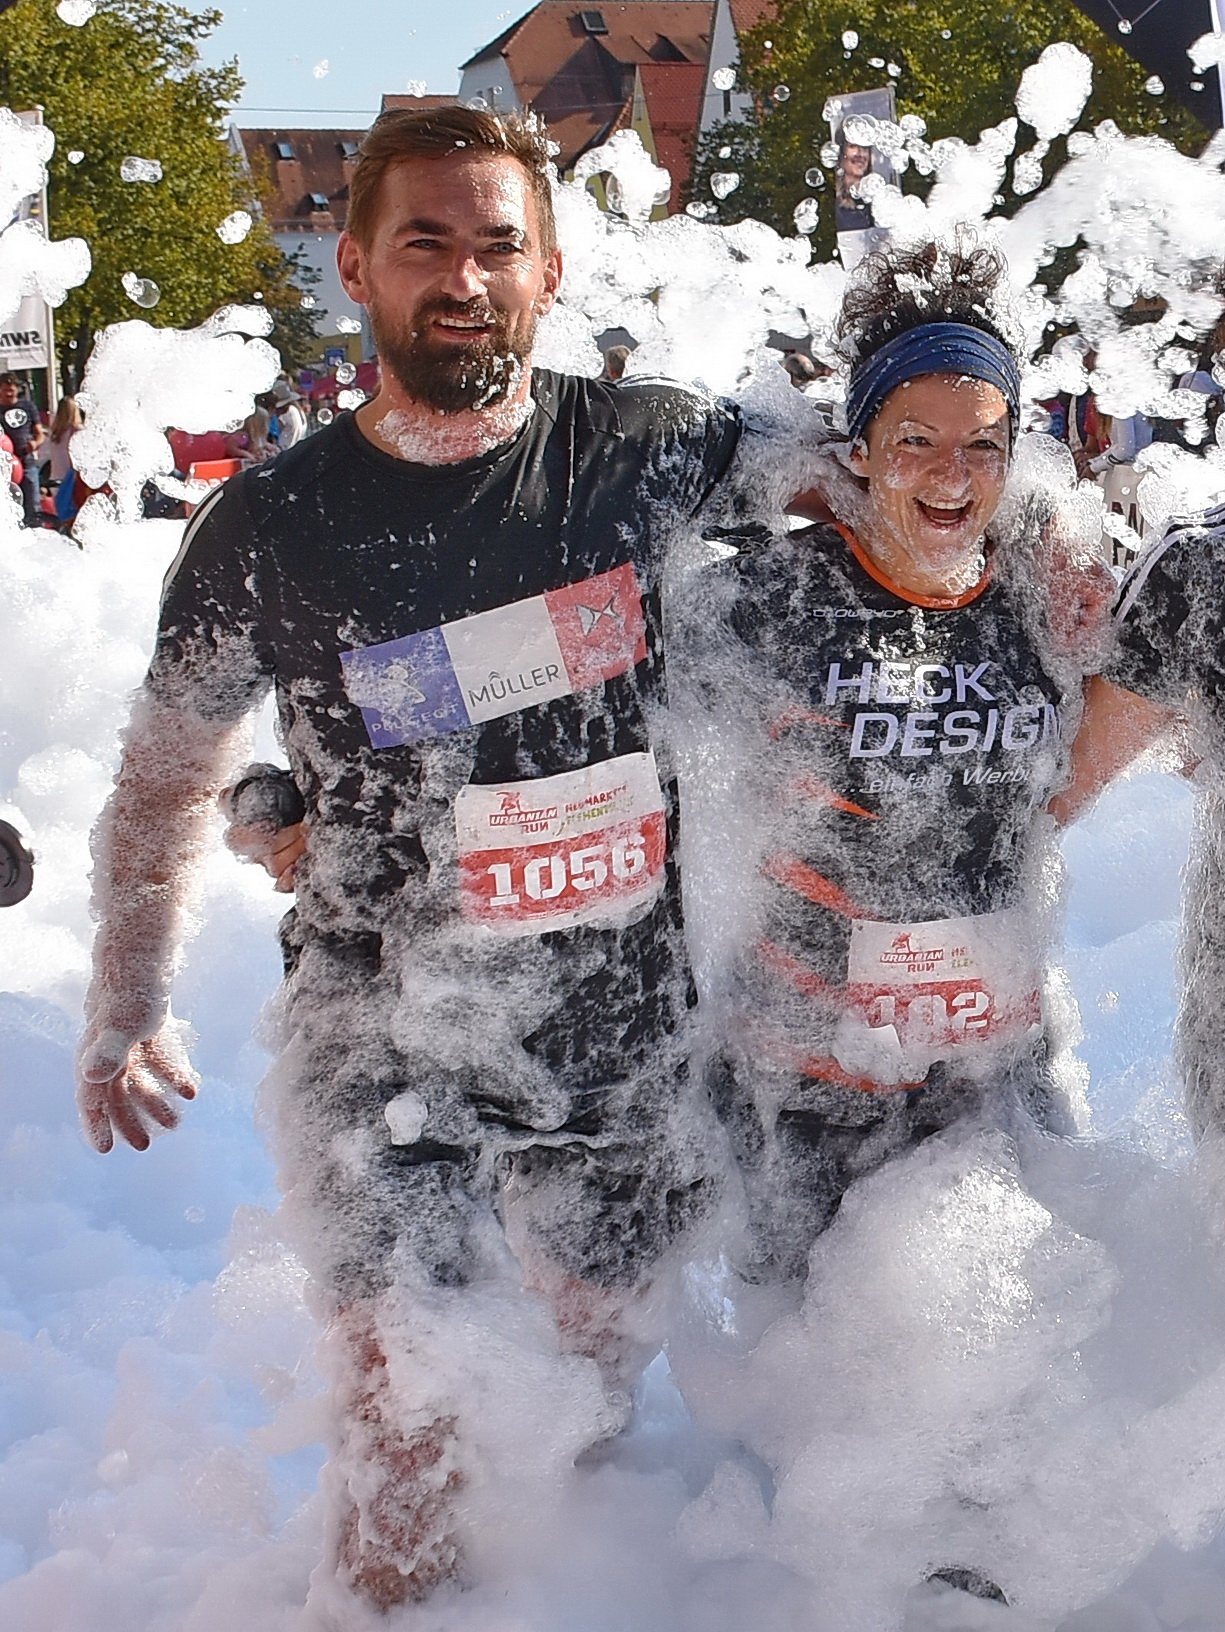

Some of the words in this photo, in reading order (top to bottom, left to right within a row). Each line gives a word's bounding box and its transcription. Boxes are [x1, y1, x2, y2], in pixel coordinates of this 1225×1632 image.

[825, 661, 996, 705] HECK
[491, 808, 557, 825] URBANIAN
[521, 821, 549, 835] RUN
[487, 835, 646, 907] 1056
[881, 949, 944, 963] URBANIAN
[907, 963, 935, 973] RUN
